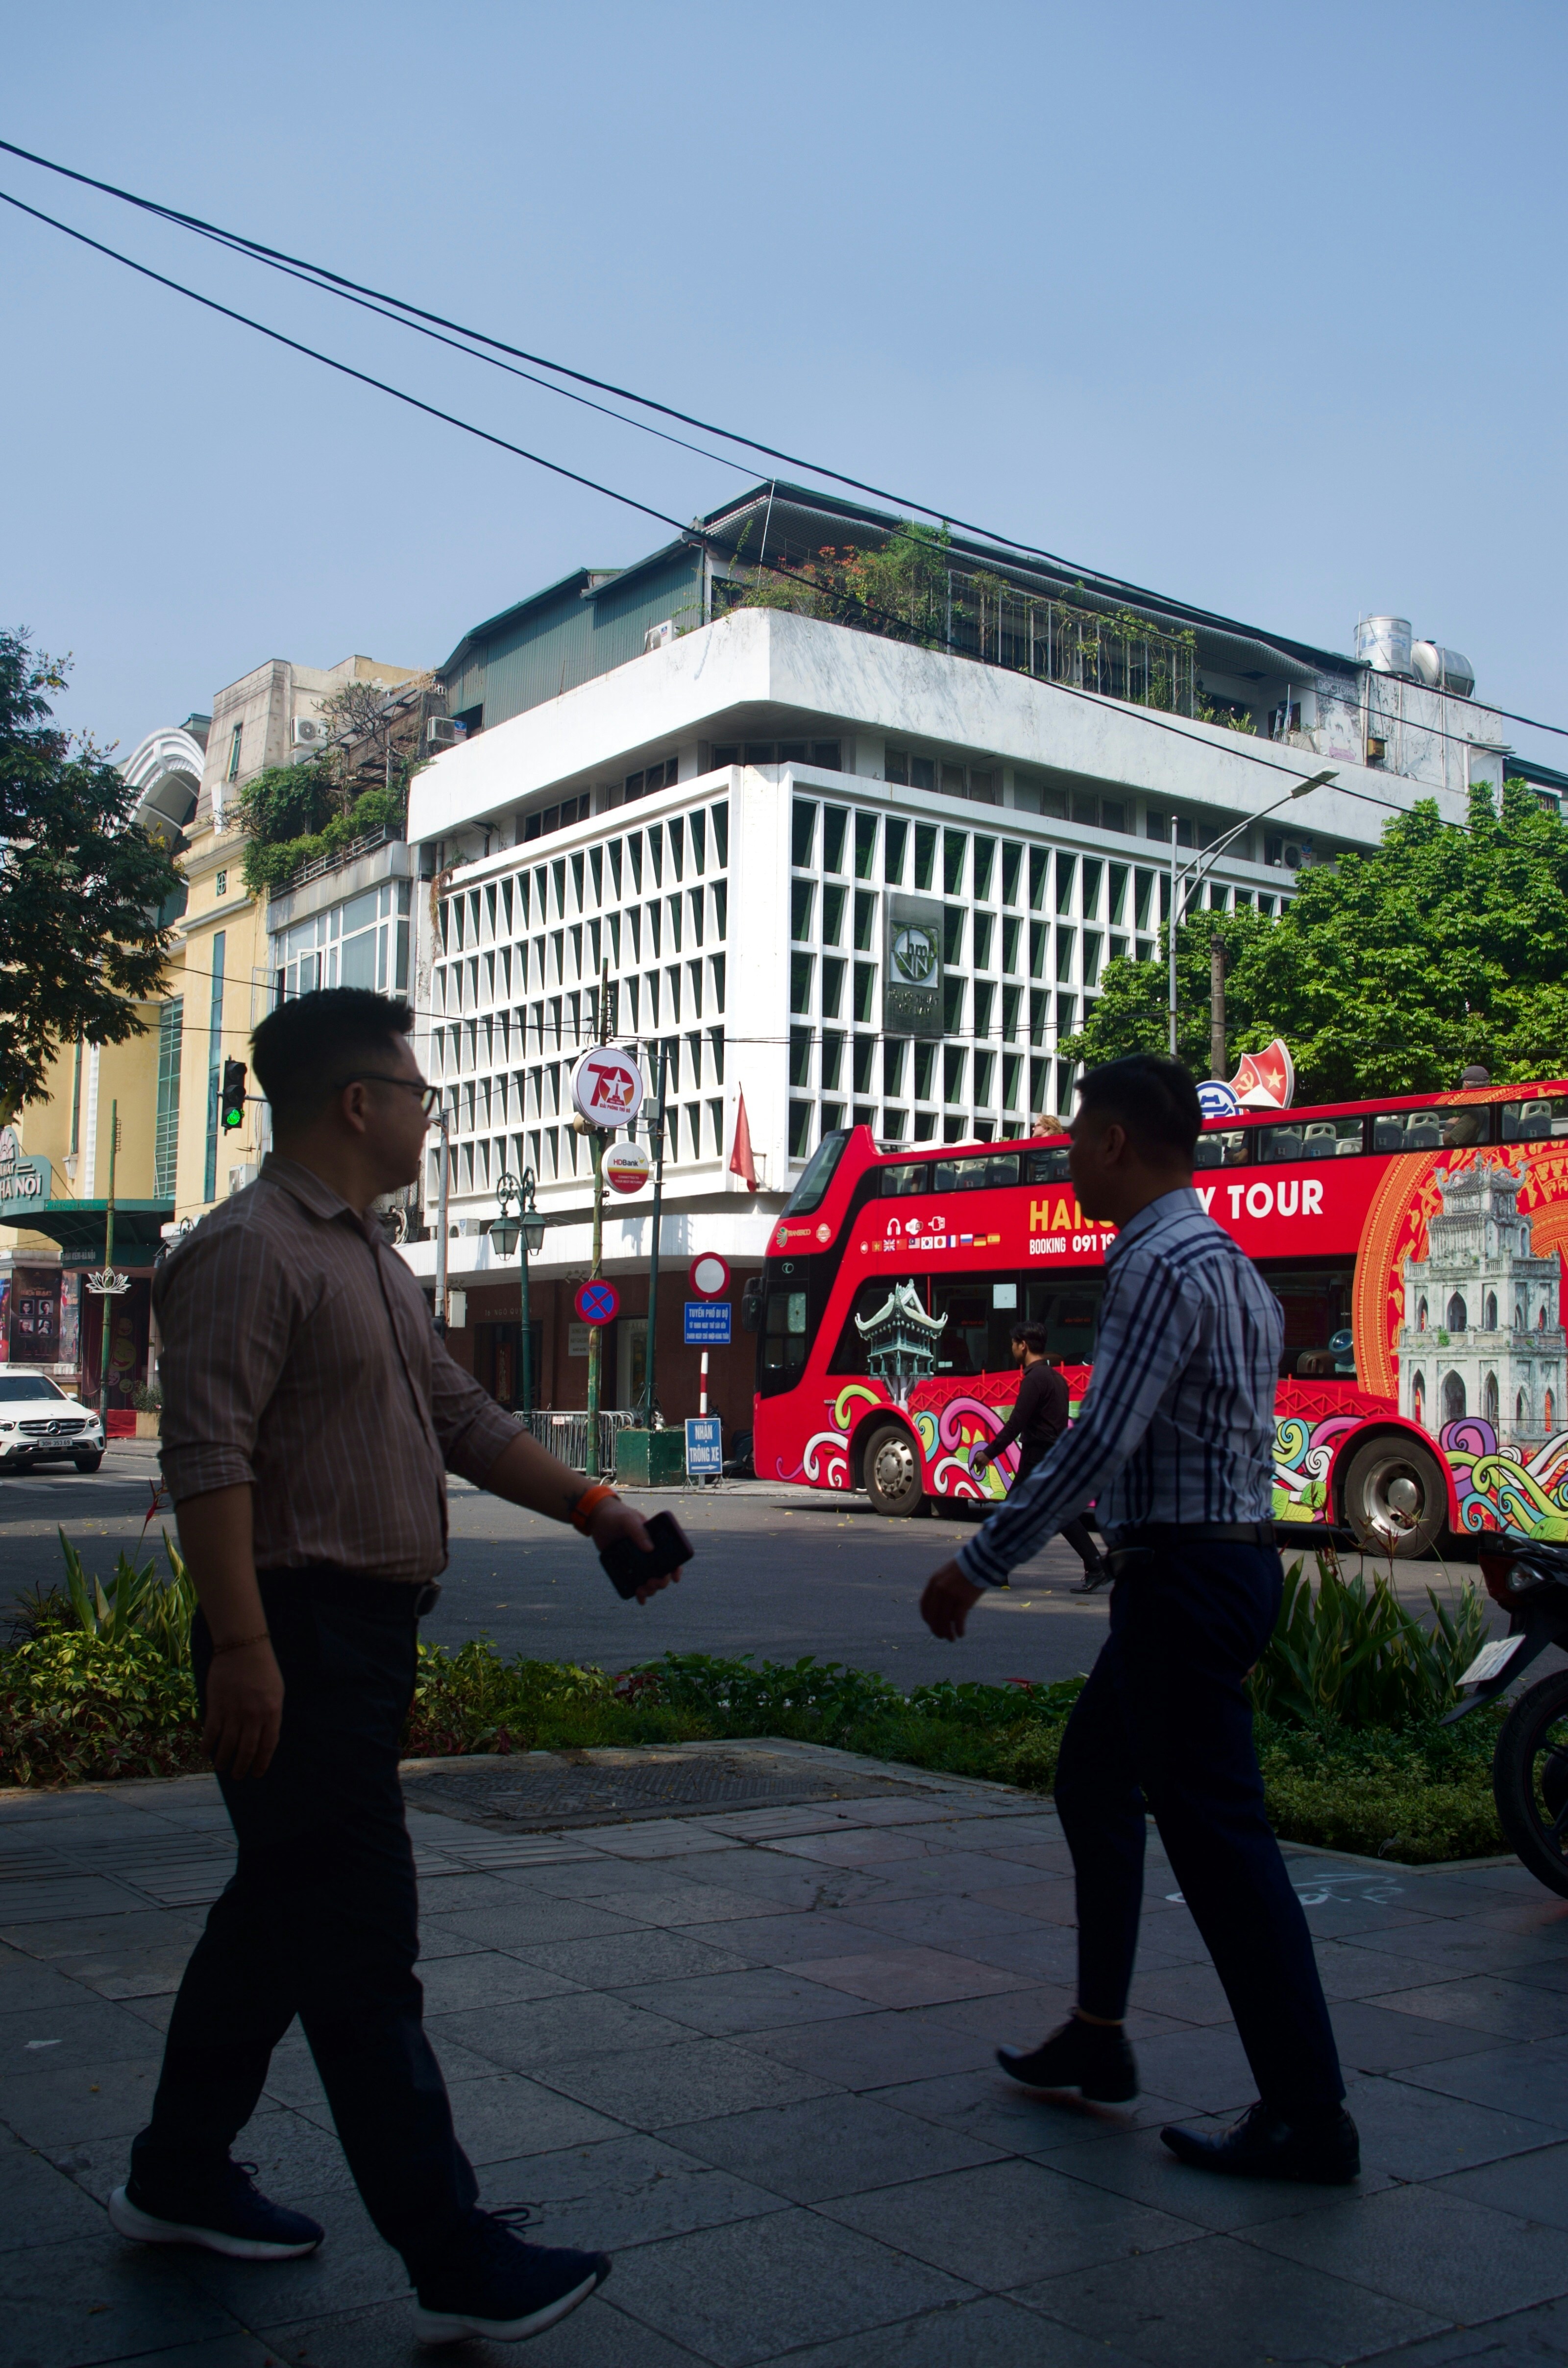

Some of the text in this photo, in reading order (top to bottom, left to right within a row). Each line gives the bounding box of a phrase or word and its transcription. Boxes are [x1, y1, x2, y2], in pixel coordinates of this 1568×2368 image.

[1318, 679, 1356, 697] DOCTORS
[1227, 1180, 1323, 1219] TOUR
[1029, 1199, 1114, 1232] HAN
[1030, 1237, 1066, 1255] BOOKING
[1073, 1234, 1097, 1252] 091
[494, 1307, 507, 1315] NGÔ
[510, 1307, 532, 1315] QUYN
[689, 1307, 705, 1318] TUYẾN
[706, 1307, 716, 1318] PHỐ
[722, 1307, 728, 1320] BỘ
[695, 1422, 713, 1443] NHẬN
[689, 1444, 720, 1462] TRÔNG XE
